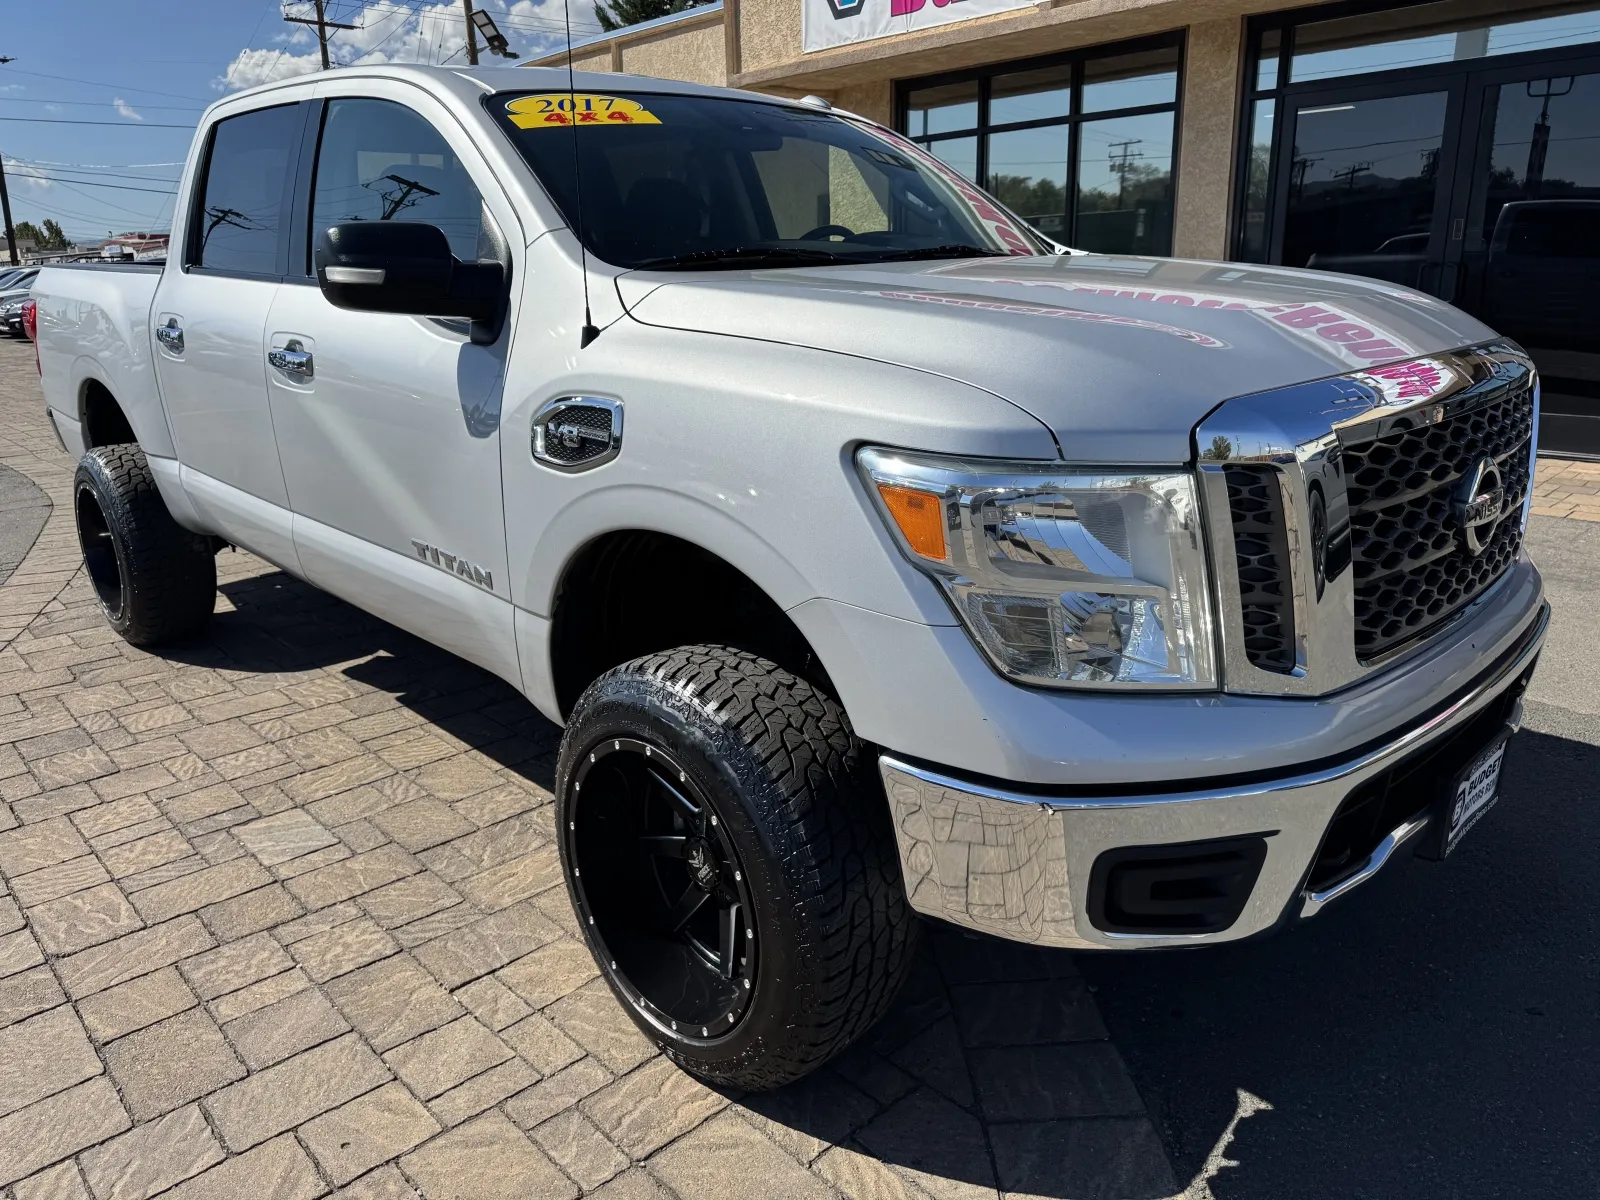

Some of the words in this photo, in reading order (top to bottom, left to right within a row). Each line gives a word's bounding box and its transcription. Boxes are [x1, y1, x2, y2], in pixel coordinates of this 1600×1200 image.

[535, 98, 616, 114] 2017
[410, 537, 494, 591] TITAN
[1467, 753, 1503, 797] BUDGET
